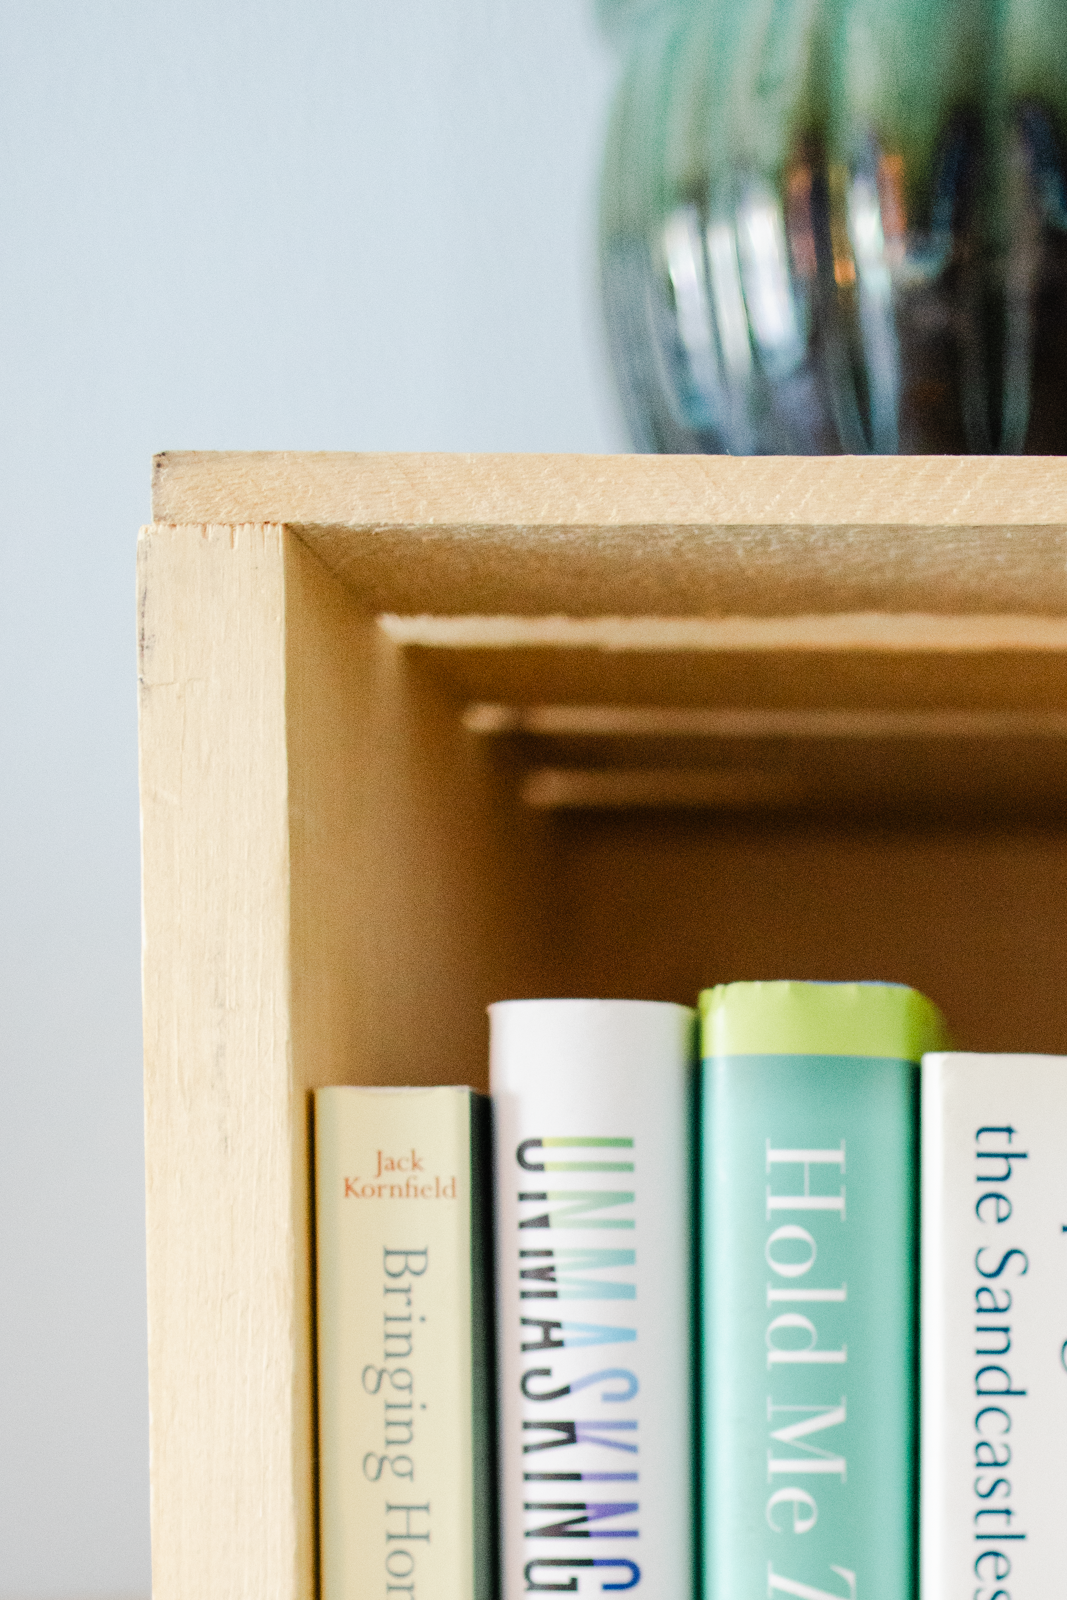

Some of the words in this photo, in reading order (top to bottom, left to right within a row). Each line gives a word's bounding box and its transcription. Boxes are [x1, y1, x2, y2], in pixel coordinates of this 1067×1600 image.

[343, 1176, 457, 1200] Kornfield
[375, 1149, 424, 1173] Jack
[975, 1124, 1029, 1224] the
[765, 1138, 847, 1370] Hold
[362, 1246, 428, 1482] Bringing
[515, 1137, 641, 1592] UNMASKING
[765, 1395, 847, 1534] Me
